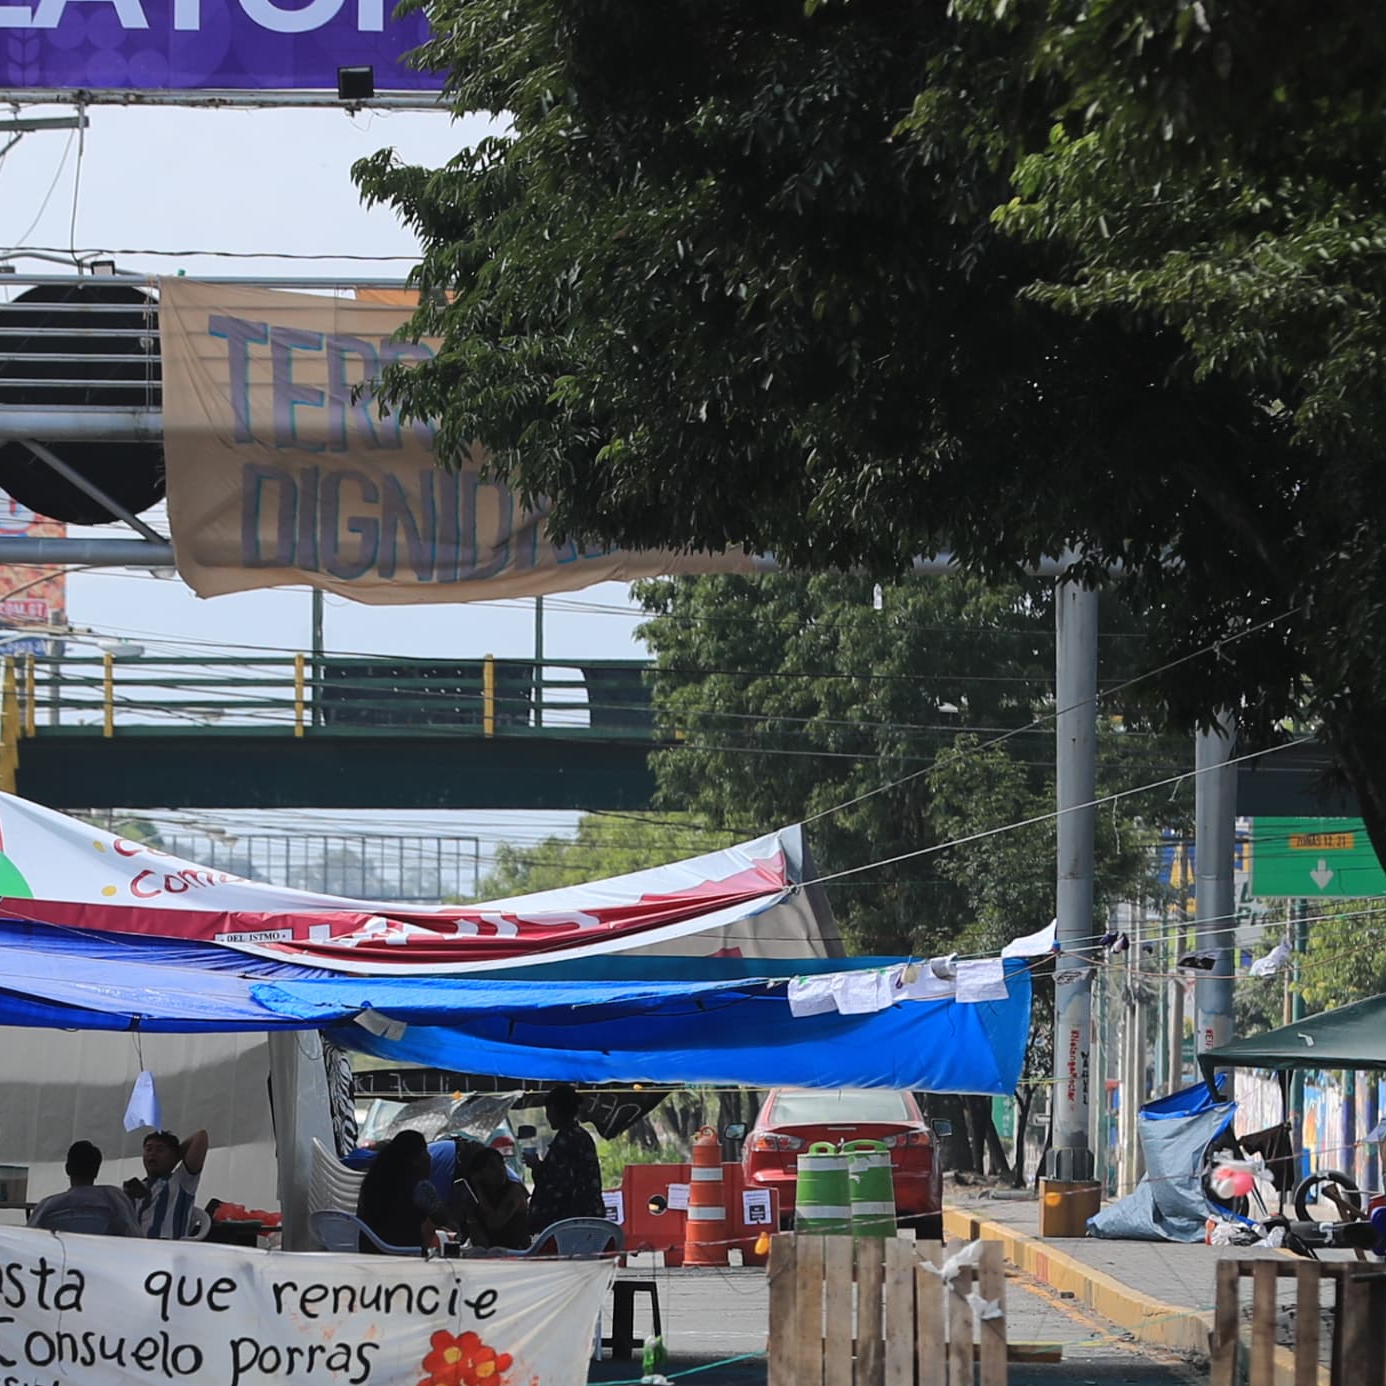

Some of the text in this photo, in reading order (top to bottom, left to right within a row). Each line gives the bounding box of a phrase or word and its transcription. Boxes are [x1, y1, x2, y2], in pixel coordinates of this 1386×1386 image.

[226, 931, 281, 943] DEL ISTMO
[144, 1270, 238, 1322] que
[272, 1278, 499, 1319] renuncie
